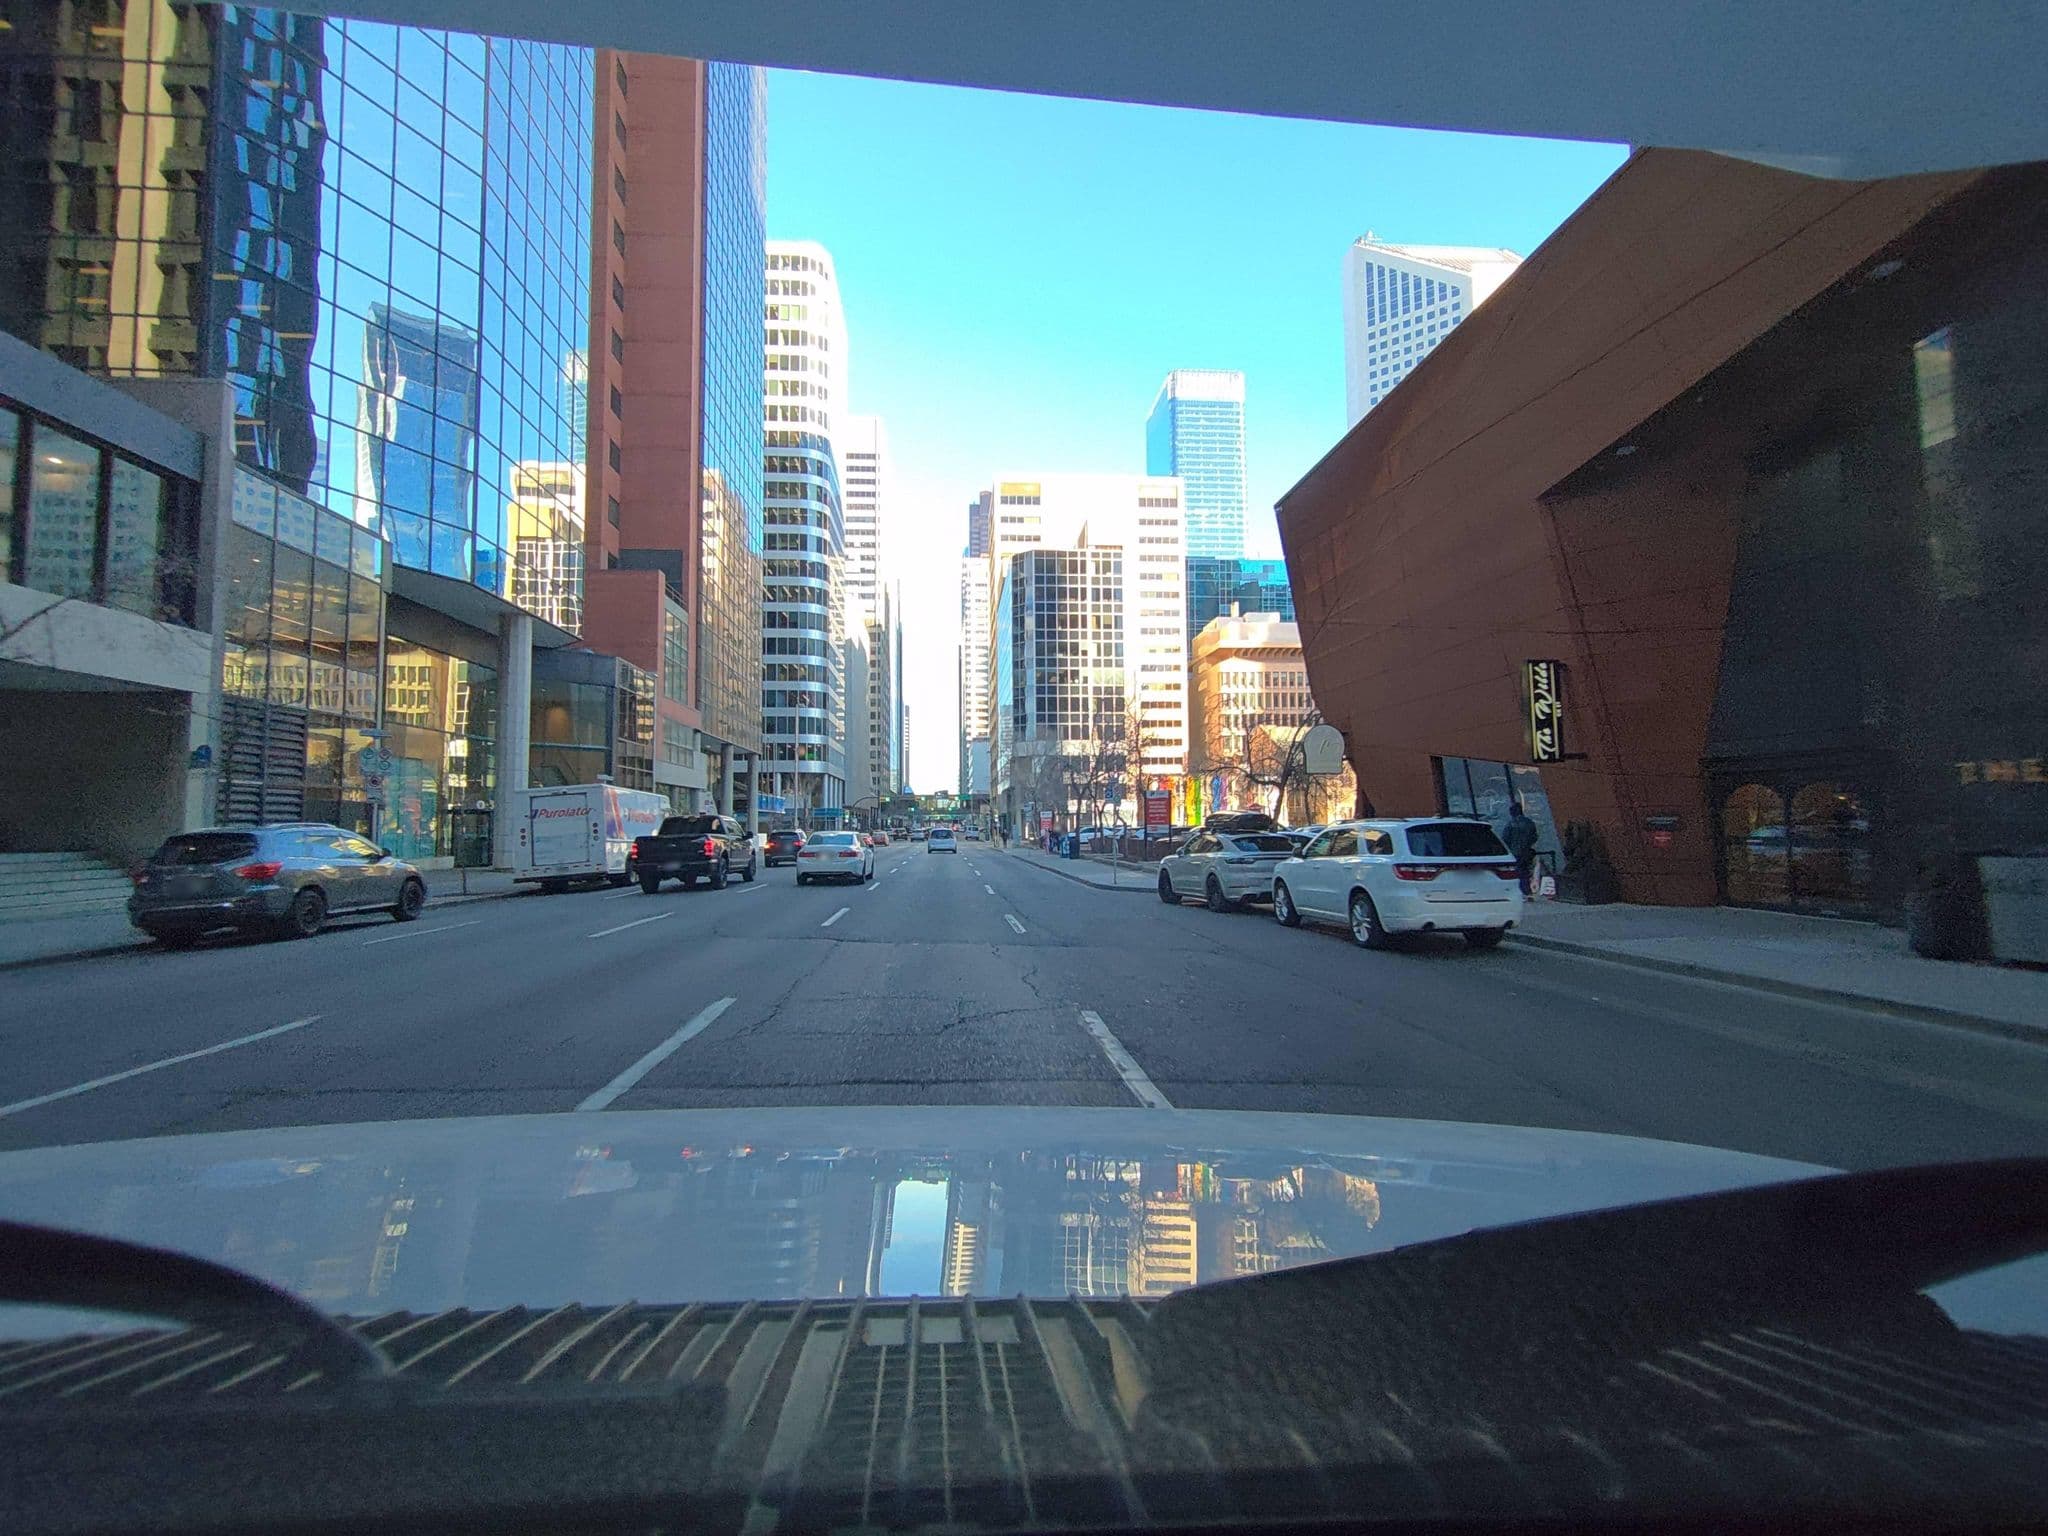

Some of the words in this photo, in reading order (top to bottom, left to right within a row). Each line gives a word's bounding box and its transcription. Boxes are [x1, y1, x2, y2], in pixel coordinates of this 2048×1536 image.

[1534, 662, 1552, 720] Wilde
[1536, 728, 1557, 760] The
[539, 808, 592, 818] Purolator
